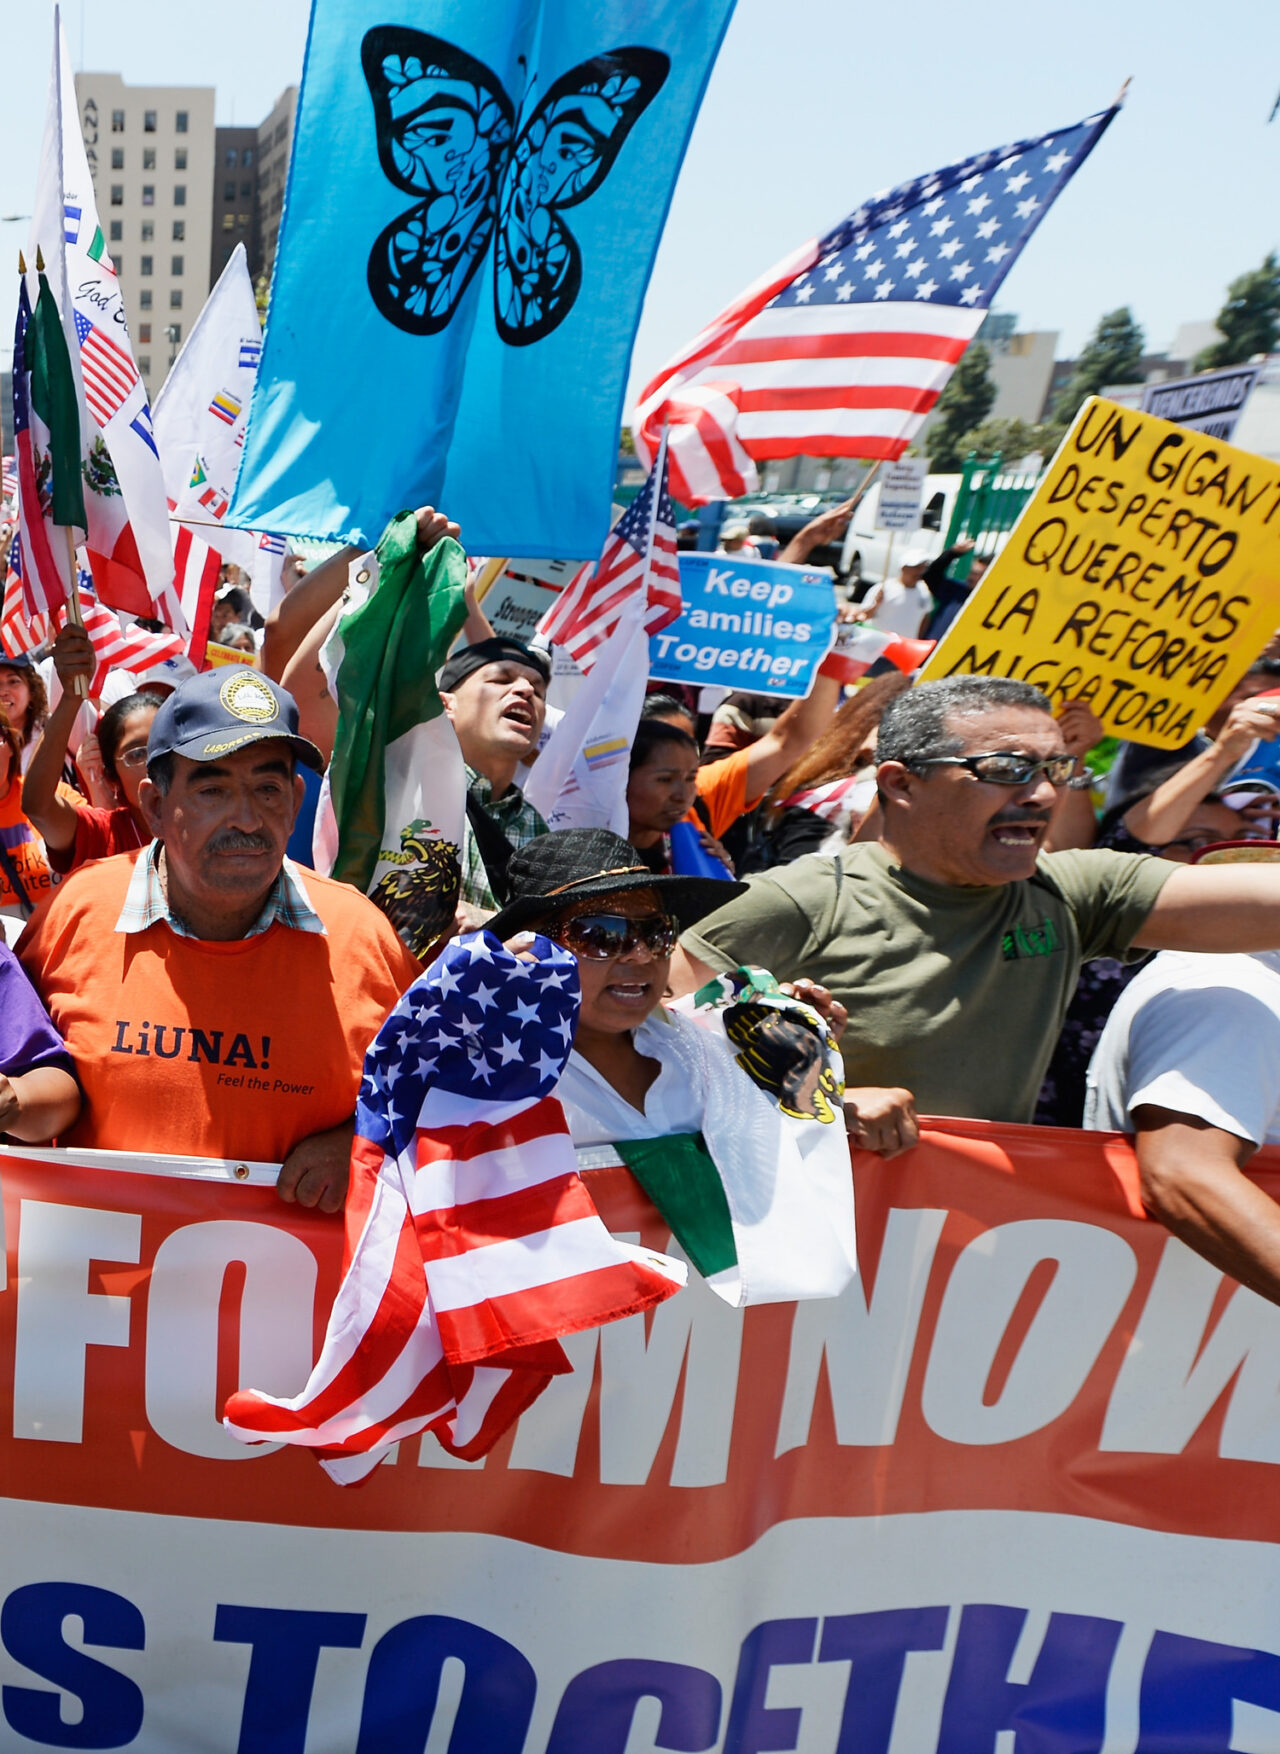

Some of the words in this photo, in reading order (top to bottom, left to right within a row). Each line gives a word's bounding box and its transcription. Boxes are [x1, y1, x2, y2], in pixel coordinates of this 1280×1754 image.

[75, 280, 118, 311] God
[1075, 404, 1143, 462] UN
[1048, 463, 1239, 578] DESPERTO
[704, 567, 794, 609] Keep
[1023, 516, 1251, 643] QUEREMOS
[656, 634, 809, 678] Together
[981, 585, 1040, 635] LA
[1053, 601, 1229, 694] REFORMA
[943, 644, 1196, 741] MIGRATORIA
[111, 1020, 272, 1070] LiUNA!
[216, 1073, 245, 1088] Feel
[248, 1076, 270, 1091] the
[273, 1079, 315, 1096] Power
